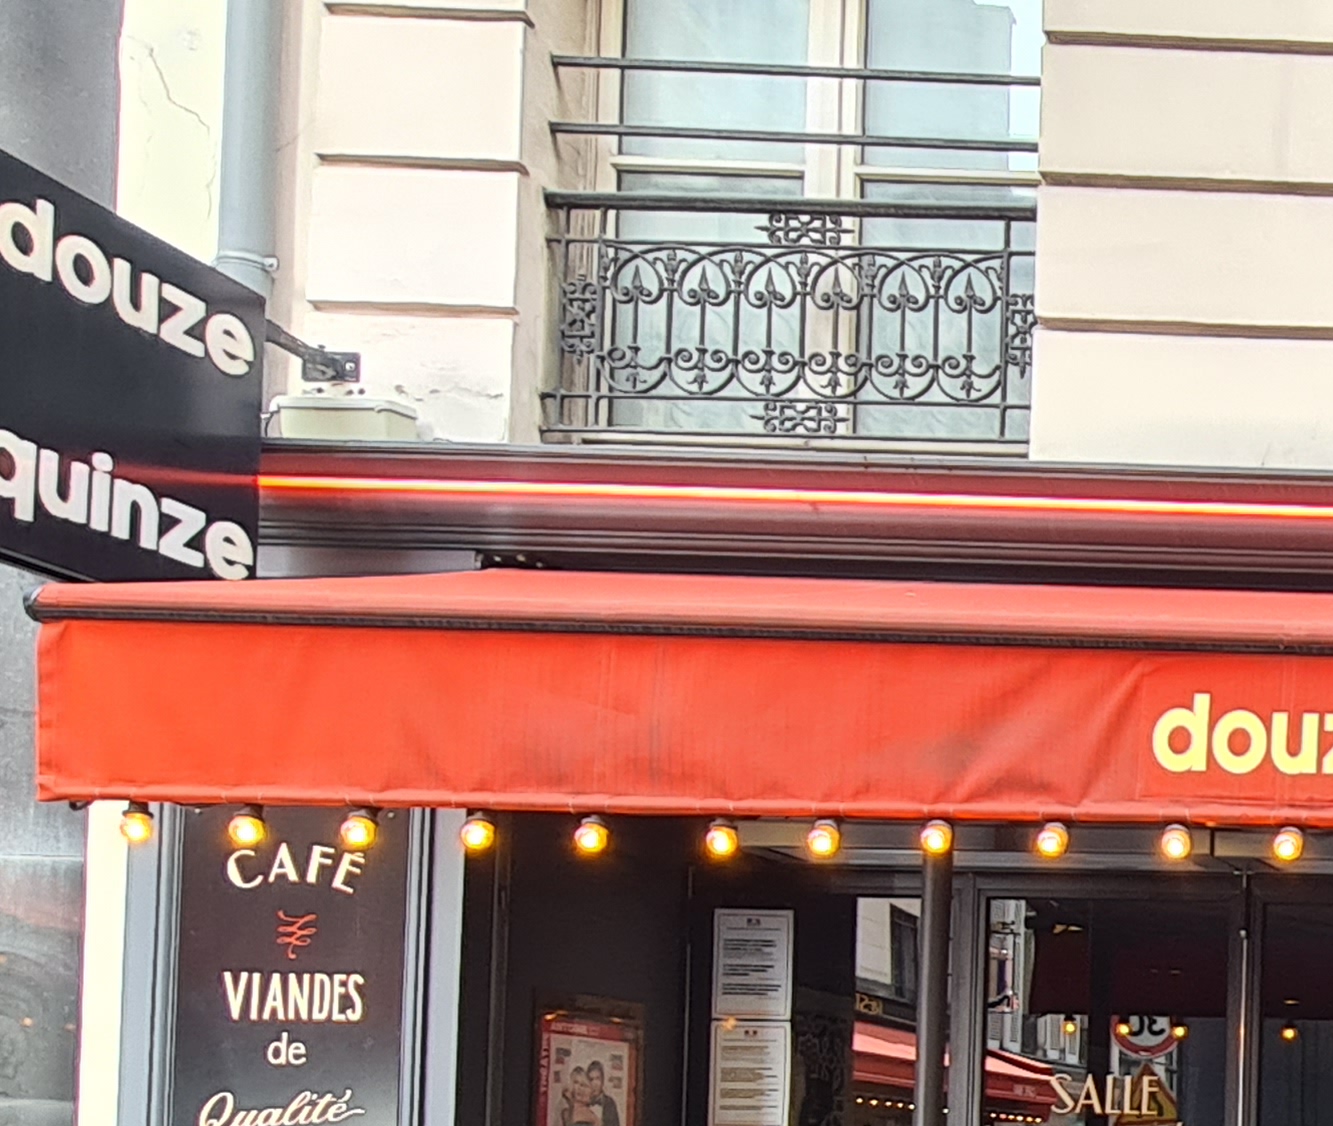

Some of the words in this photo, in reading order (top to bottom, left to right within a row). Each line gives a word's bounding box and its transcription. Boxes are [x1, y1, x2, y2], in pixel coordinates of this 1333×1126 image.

[0, 198, 255, 376] douze
[0, 428, 254, 581] quinze
[226, 842, 367, 895] CAFÉ
[222, 971, 366, 1022] VIANDES
[267, 1031, 307, 1066] de
[1050, 1073, 1159, 1116] SALLE
